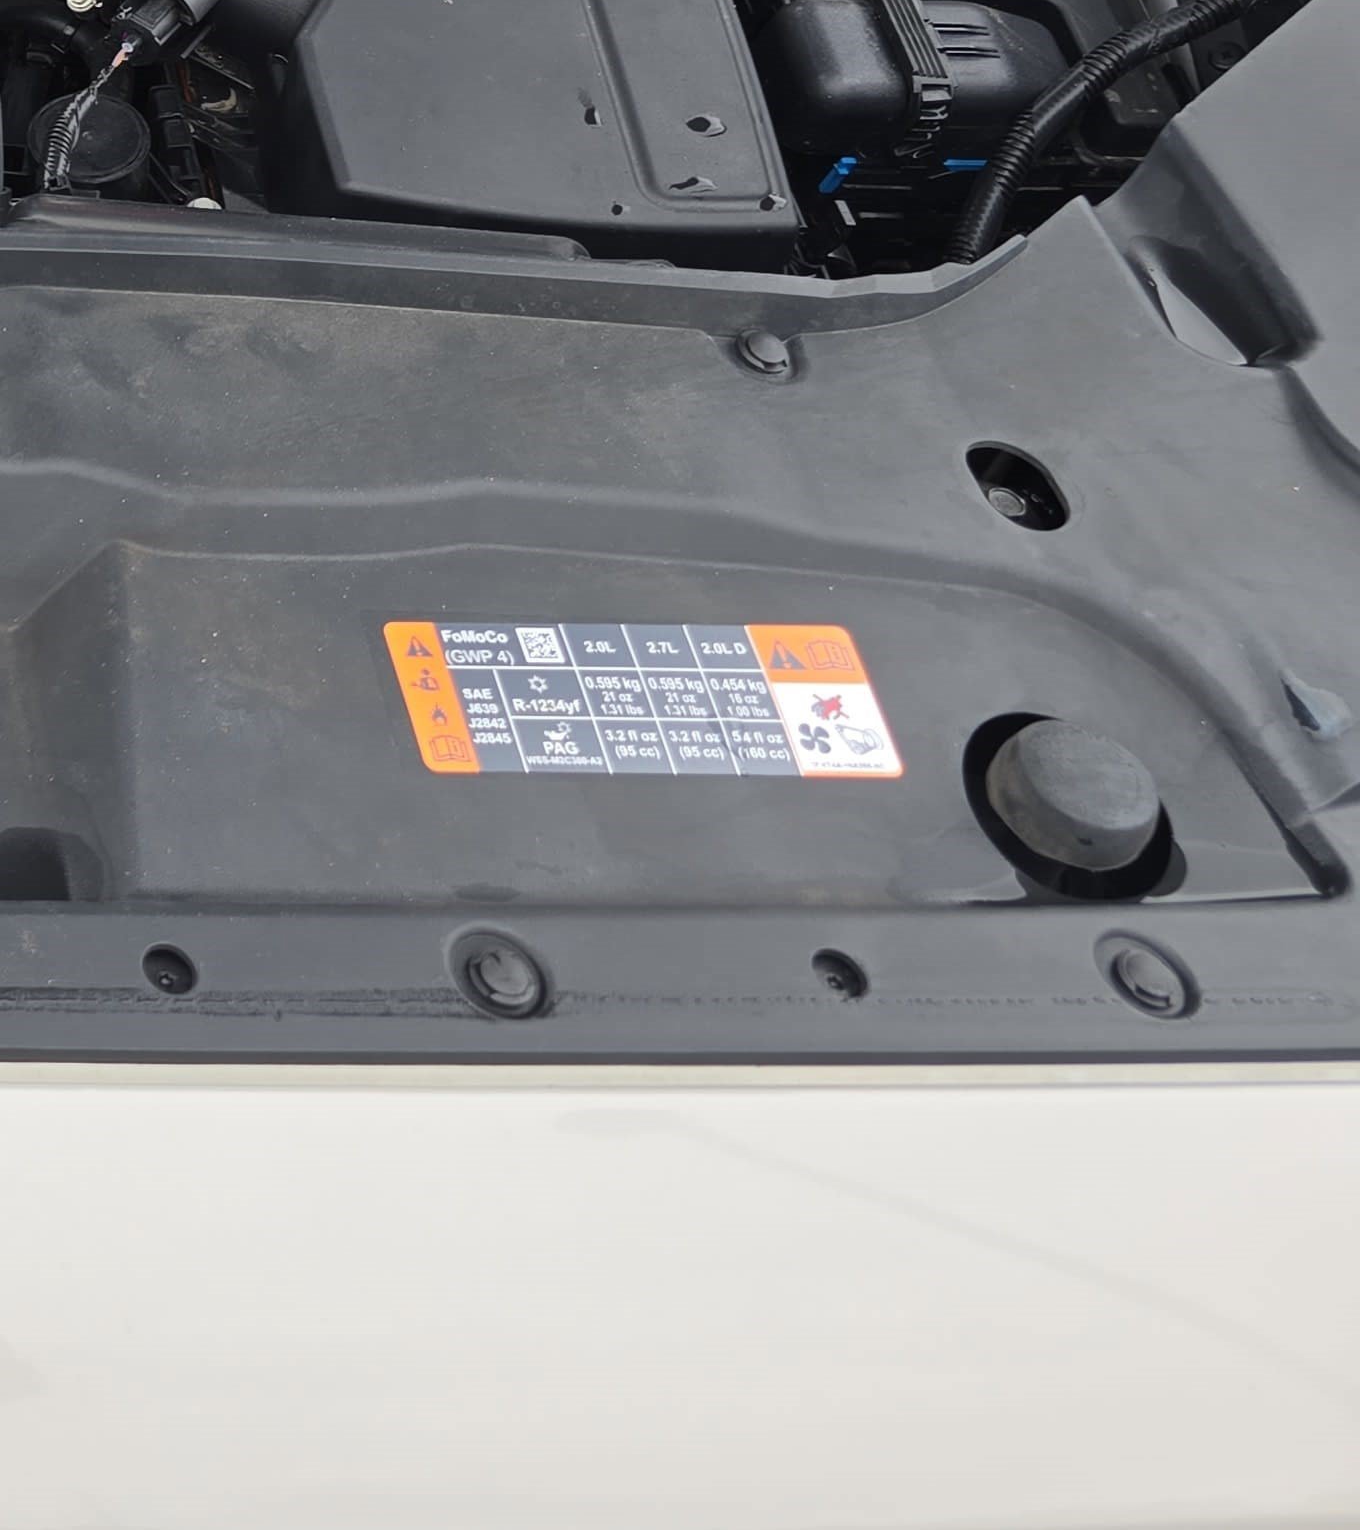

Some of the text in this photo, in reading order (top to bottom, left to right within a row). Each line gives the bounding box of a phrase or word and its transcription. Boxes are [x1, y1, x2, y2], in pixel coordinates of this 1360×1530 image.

[441, 629, 509, 644] FoMoCo
[583, 641, 616, 653] 2.0L
[646, 641, 679, 654] 2.7L
[701, 642, 746, 654] 2.0L D
[445, 650, 514, 666] (GWP 4)
[585, 676, 641, 692] 0.595 kg
[648, 677, 705, 693] 0.595 kg
[710, 678, 767, 694] 0.454 kg
[462, 688, 493, 699] SAE
[602, 691, 633, 702] 21 oz
[667, 692, 696, 703] 21 oz
[744, 694, 759, 704] oz
[467, 703, 499, 714] J639
[512, 698, 581, 715] R-1234yf
[600, 703, 645, 716] 1.31 lbs
[664, 705, 708, 716] 1.31 lbs
[751, 706, 770, 717] lbs
[468, 717, 507, 729] J2842
[473, 732, 512, 744] J2845
[604, 729, 658, 742] 3.2 fl oz
[668, 730, 721, 742] 3.2 fl oz
[753, 731, 764, 744] fl
[767, 734, 783, 743] oz
[542, 741, 579, 755] PAG
[615, 746, 660, 759] (95 cc)
[679, 746, 724, 760] (95 cc)
[738, 746, 791, 761] (160 cc)
